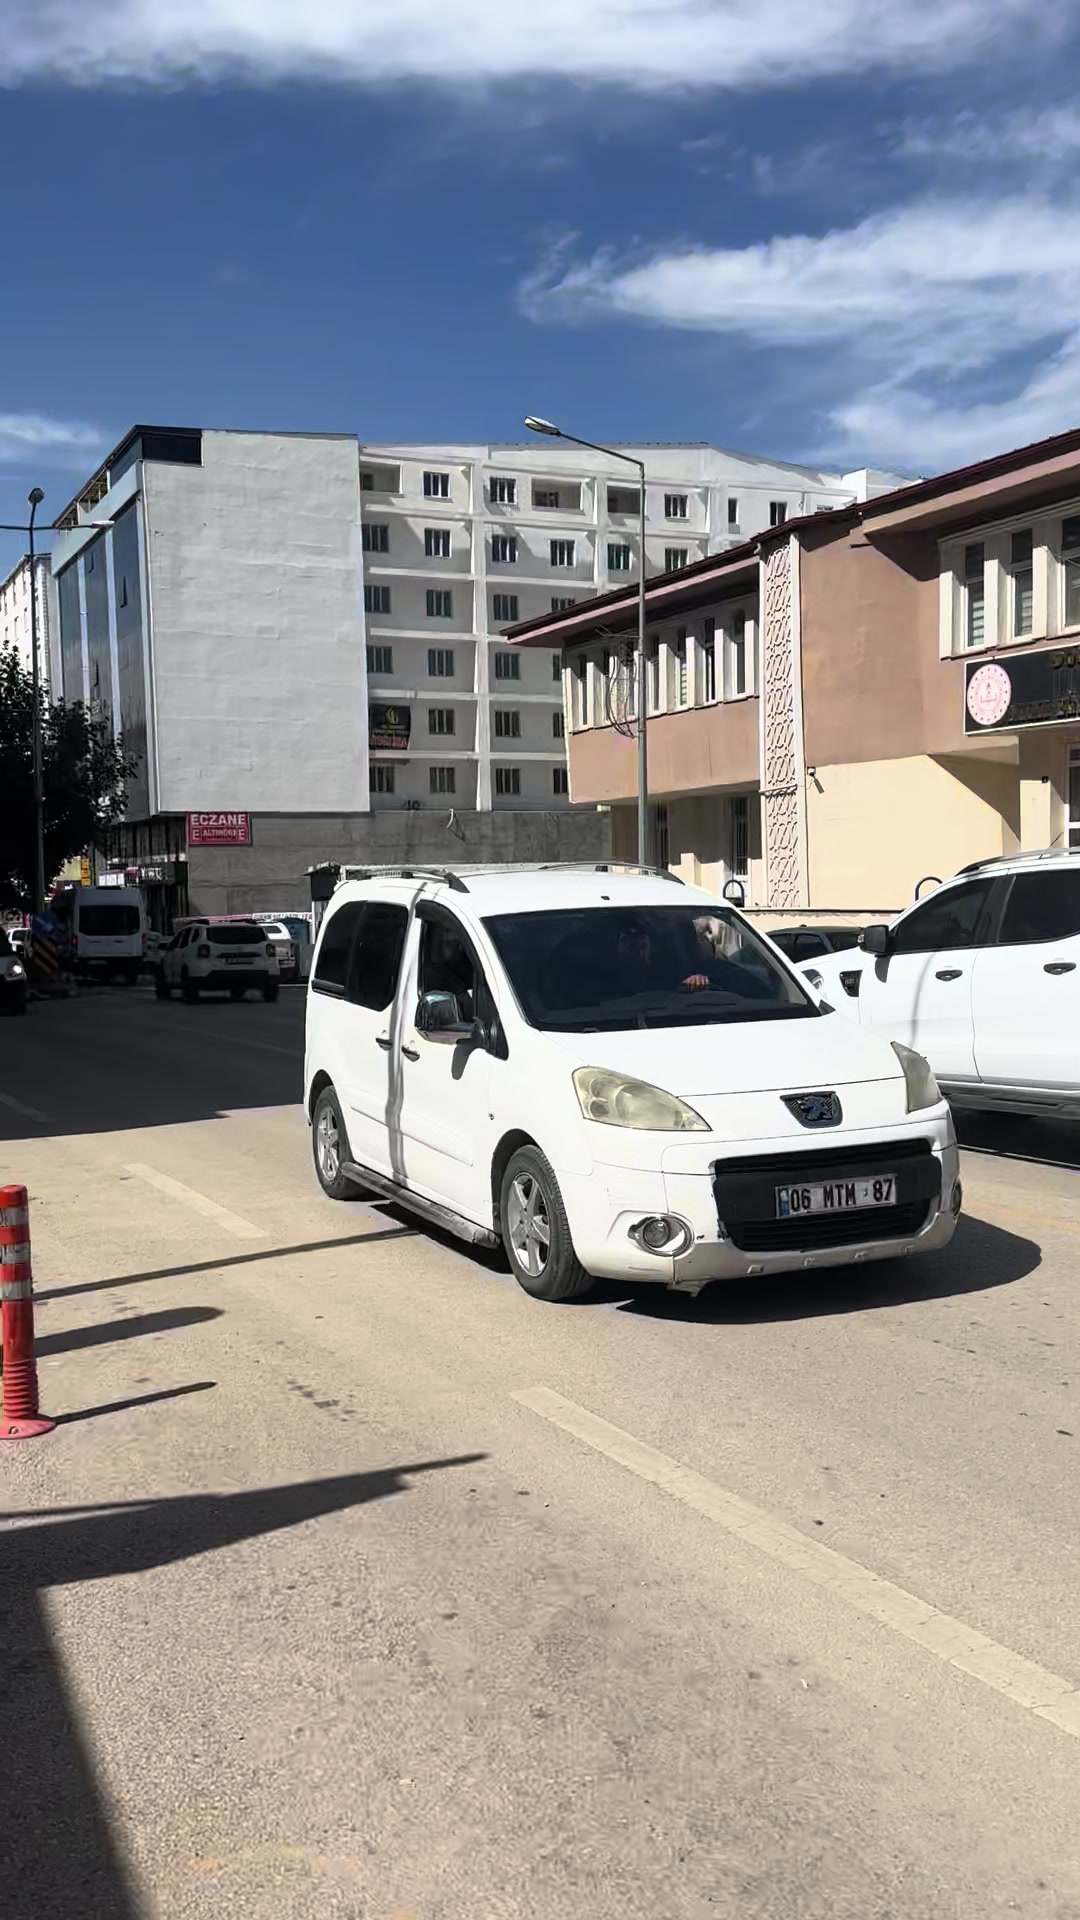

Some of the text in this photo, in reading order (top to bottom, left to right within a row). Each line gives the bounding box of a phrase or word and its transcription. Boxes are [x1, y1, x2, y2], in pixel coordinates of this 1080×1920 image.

[191, 814, 246, 825] ECZANE
[791, 1189, 811, 1211] 06
[823, 1183, 856, 1208] MTM
[873, 1179, 893, 1202] 87
